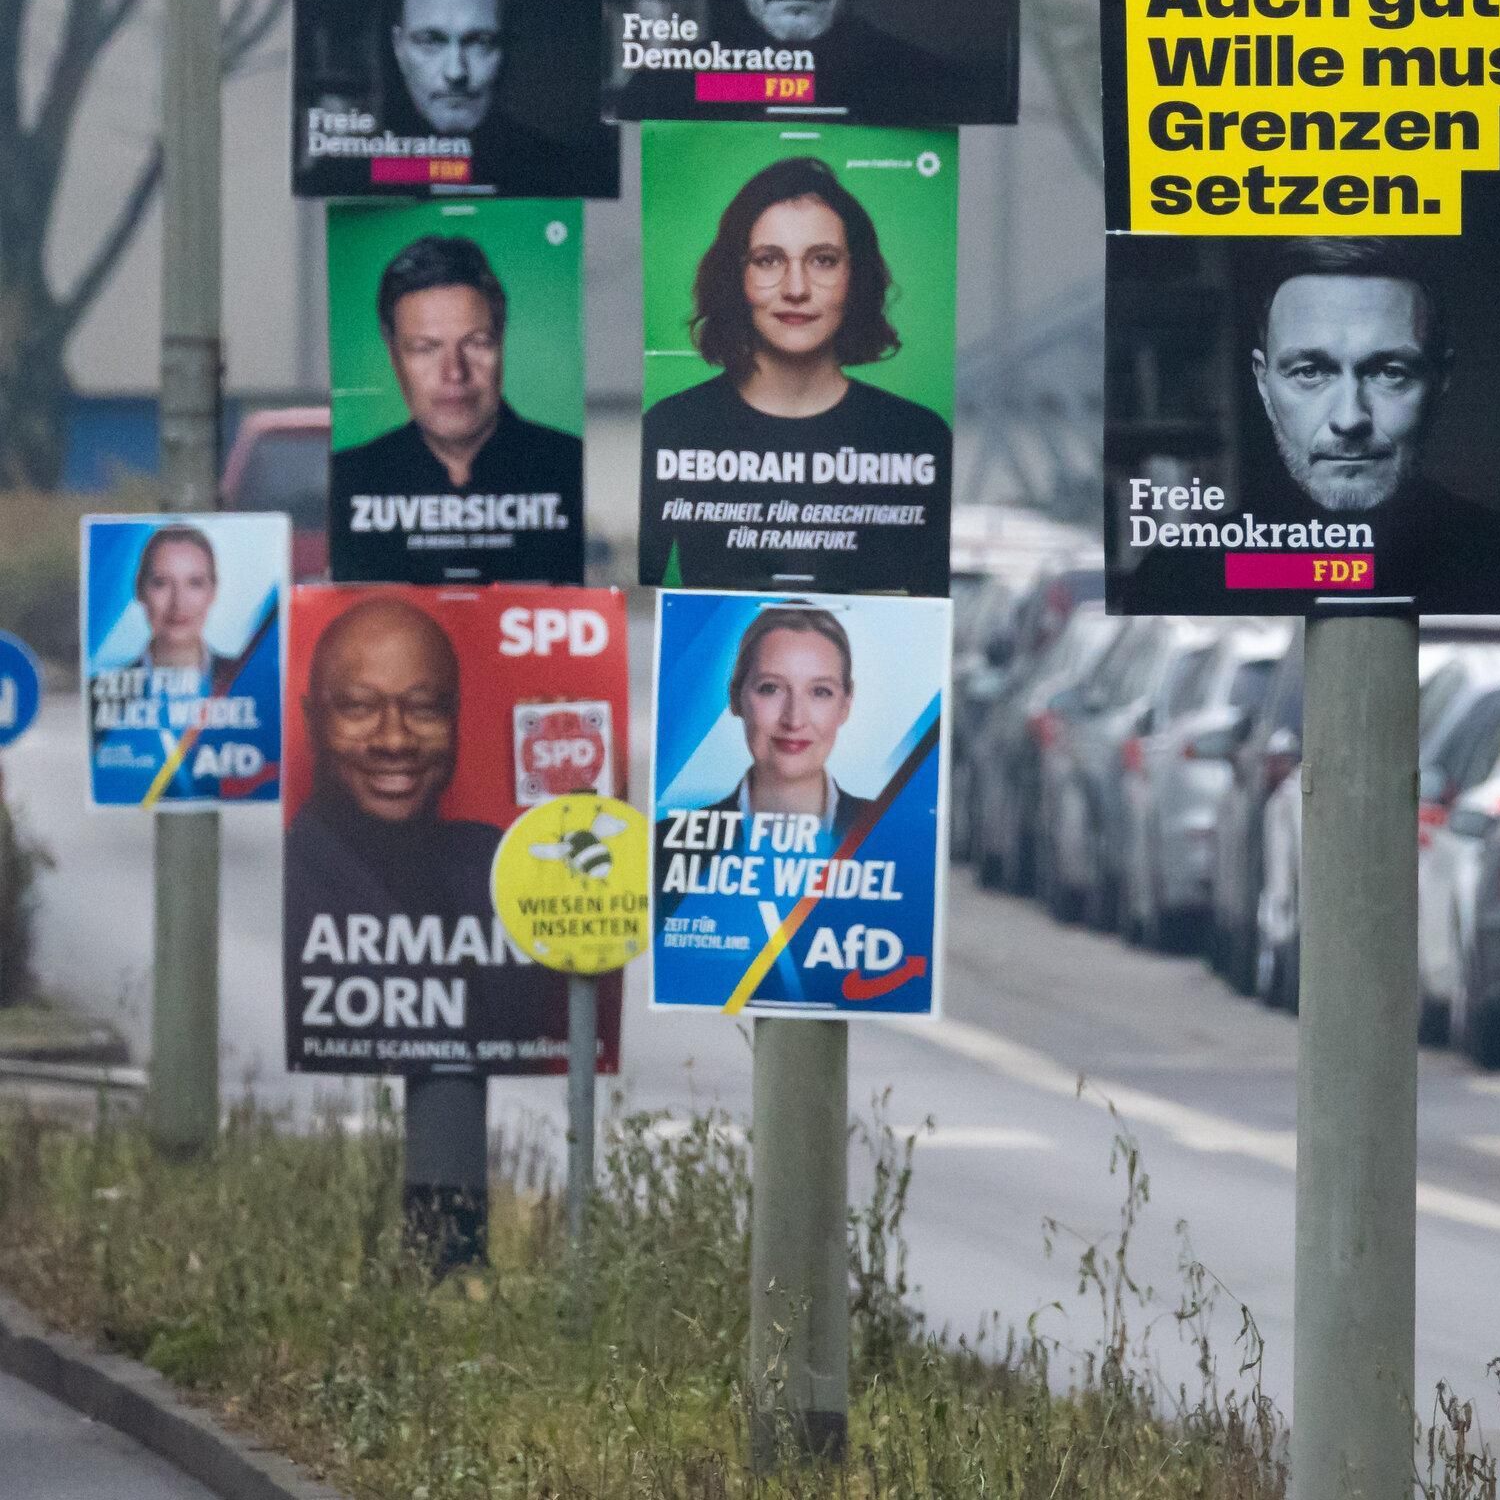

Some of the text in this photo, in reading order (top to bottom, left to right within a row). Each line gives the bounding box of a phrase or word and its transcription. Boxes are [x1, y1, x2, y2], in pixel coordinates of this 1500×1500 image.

[623, 13, 698, 41] Freie
[622, 42, 816, 72] Demokraten
[1149, 35, 1344, 87] Wille
[764, 76, 811, 98] FDP
[308, 107, 375, 133] Freie
[1147, 100, 1480, 152] Grenzen
[308, 132, 472, 158] Demokraten
[1149, 167, 1441, 216] setzen.
[656, 447, 936, 486] DEBORAH DÜRING
[1129, 478, 1225, 511] Freie
[350, 493, 568, 532] ZUVERSICHT.
[661, 498, 926, 526] FÜR FREIHEIT. FÜR GERECHTIGKEIT.
[726, 525, 858, 551] FÜR FRANKFURT.
[1129, 513, 1375, 548] Demokraten
[1312, 560, 1369, 583] FDP
[499, 608, 610, 657] SPD
[532, 739, 595, 768] SPD
[663, 809, 820, 854] ZEIT FÜR
[662, 855, 903, 901] ALICE WEIDEL
[518, 895, 604, 916] WIESEN
[532, 918, 639, 936] INSEKTEN
[803, 923, 904, 972] AfD
[301, 977, 467, 1028] ZORN
[303, 1036, 372, 1058] PLAKAT
